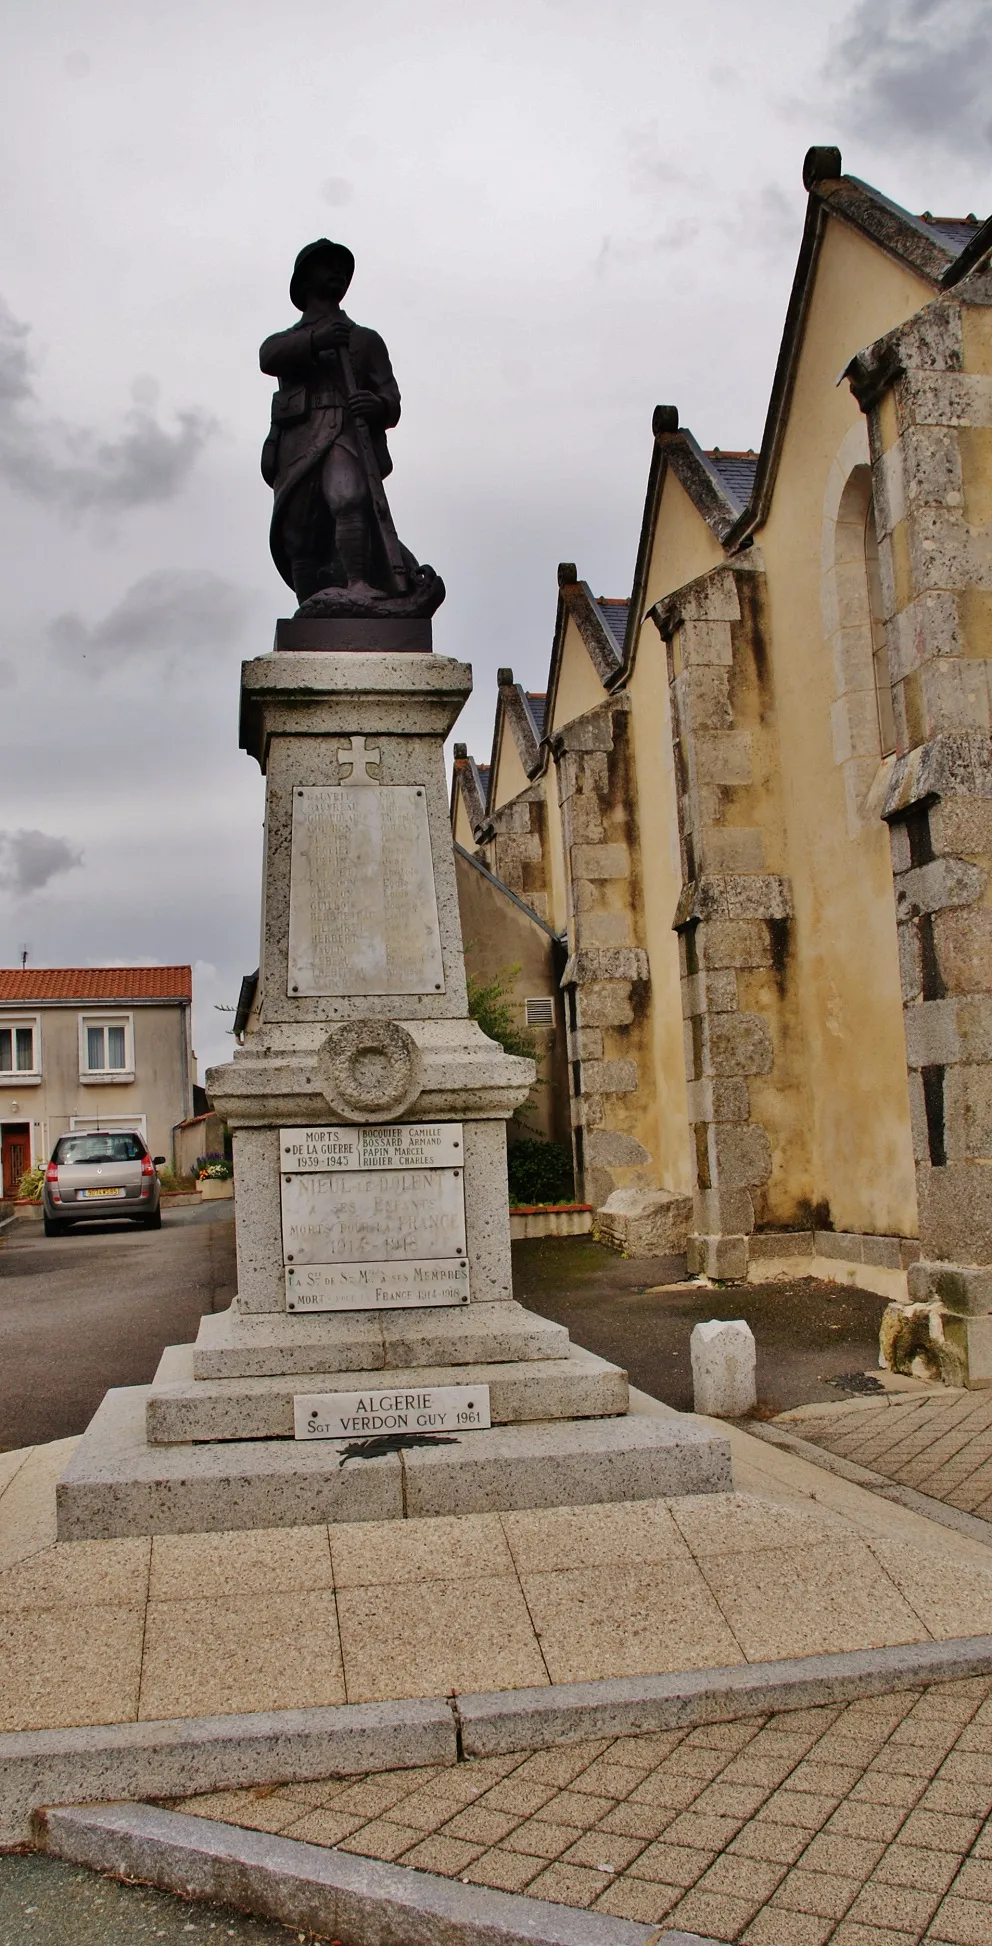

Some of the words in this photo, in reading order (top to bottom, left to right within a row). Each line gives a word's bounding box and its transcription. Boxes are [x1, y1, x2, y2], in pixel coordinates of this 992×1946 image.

[305, 1131, 340, 1142] MORTS
[362, 1128, 403, 1139] BOCQUIER
[362, 1138, 403, 1148] BOSSARD
[292, 1144, 304, 1155] DE
[306, 1144, 318, 1155] LA
[321, 1143, 354, 1154] GUERRE
[363, 1148, 389, 1157] PAPIN
[363, 1157, 393, 1166] RIDIER
[375, 1287, 412, 1302] FRANCE
[355, 1393, 432, 1413] ALGERIE
[340, 1415, 408, 1431] VERDON
[416, 1413, 448, 1427] GUY
[456, 1411, 481, 1425] 1961
